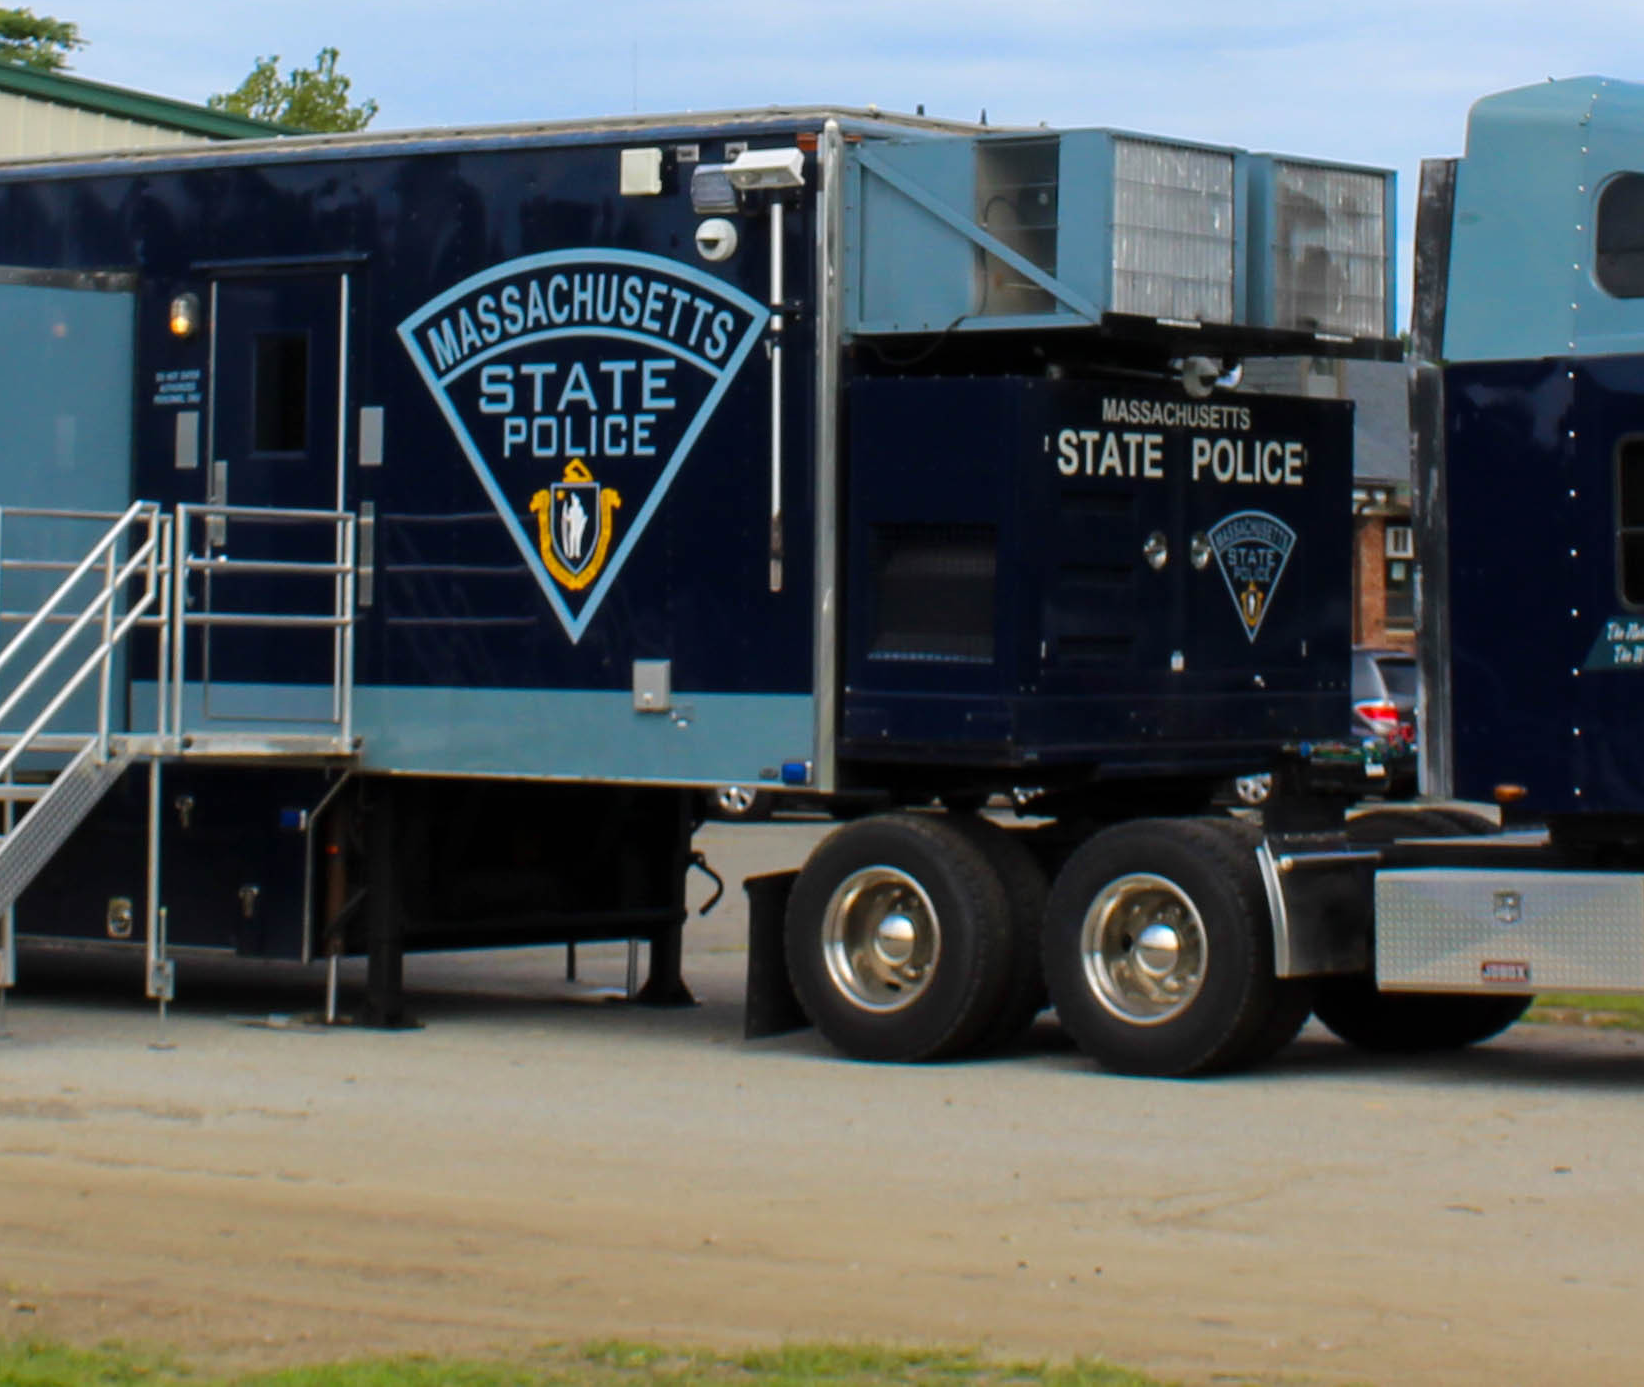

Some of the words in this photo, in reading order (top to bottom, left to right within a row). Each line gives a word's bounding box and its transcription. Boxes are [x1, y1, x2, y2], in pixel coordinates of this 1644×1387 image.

[427, 273, 735, 371] MASSACHUSETTS
[478, 359, 676, 414] STATE
[503, 414, 657, 458] POLICE
[1102, 397, 1251, 431] MASSACHUSETTS
[1057, 428, 1164, 479] STATE
[1192, 437, 1304, 485] POLICE
[1228, 547, 1276, 566] STATE
